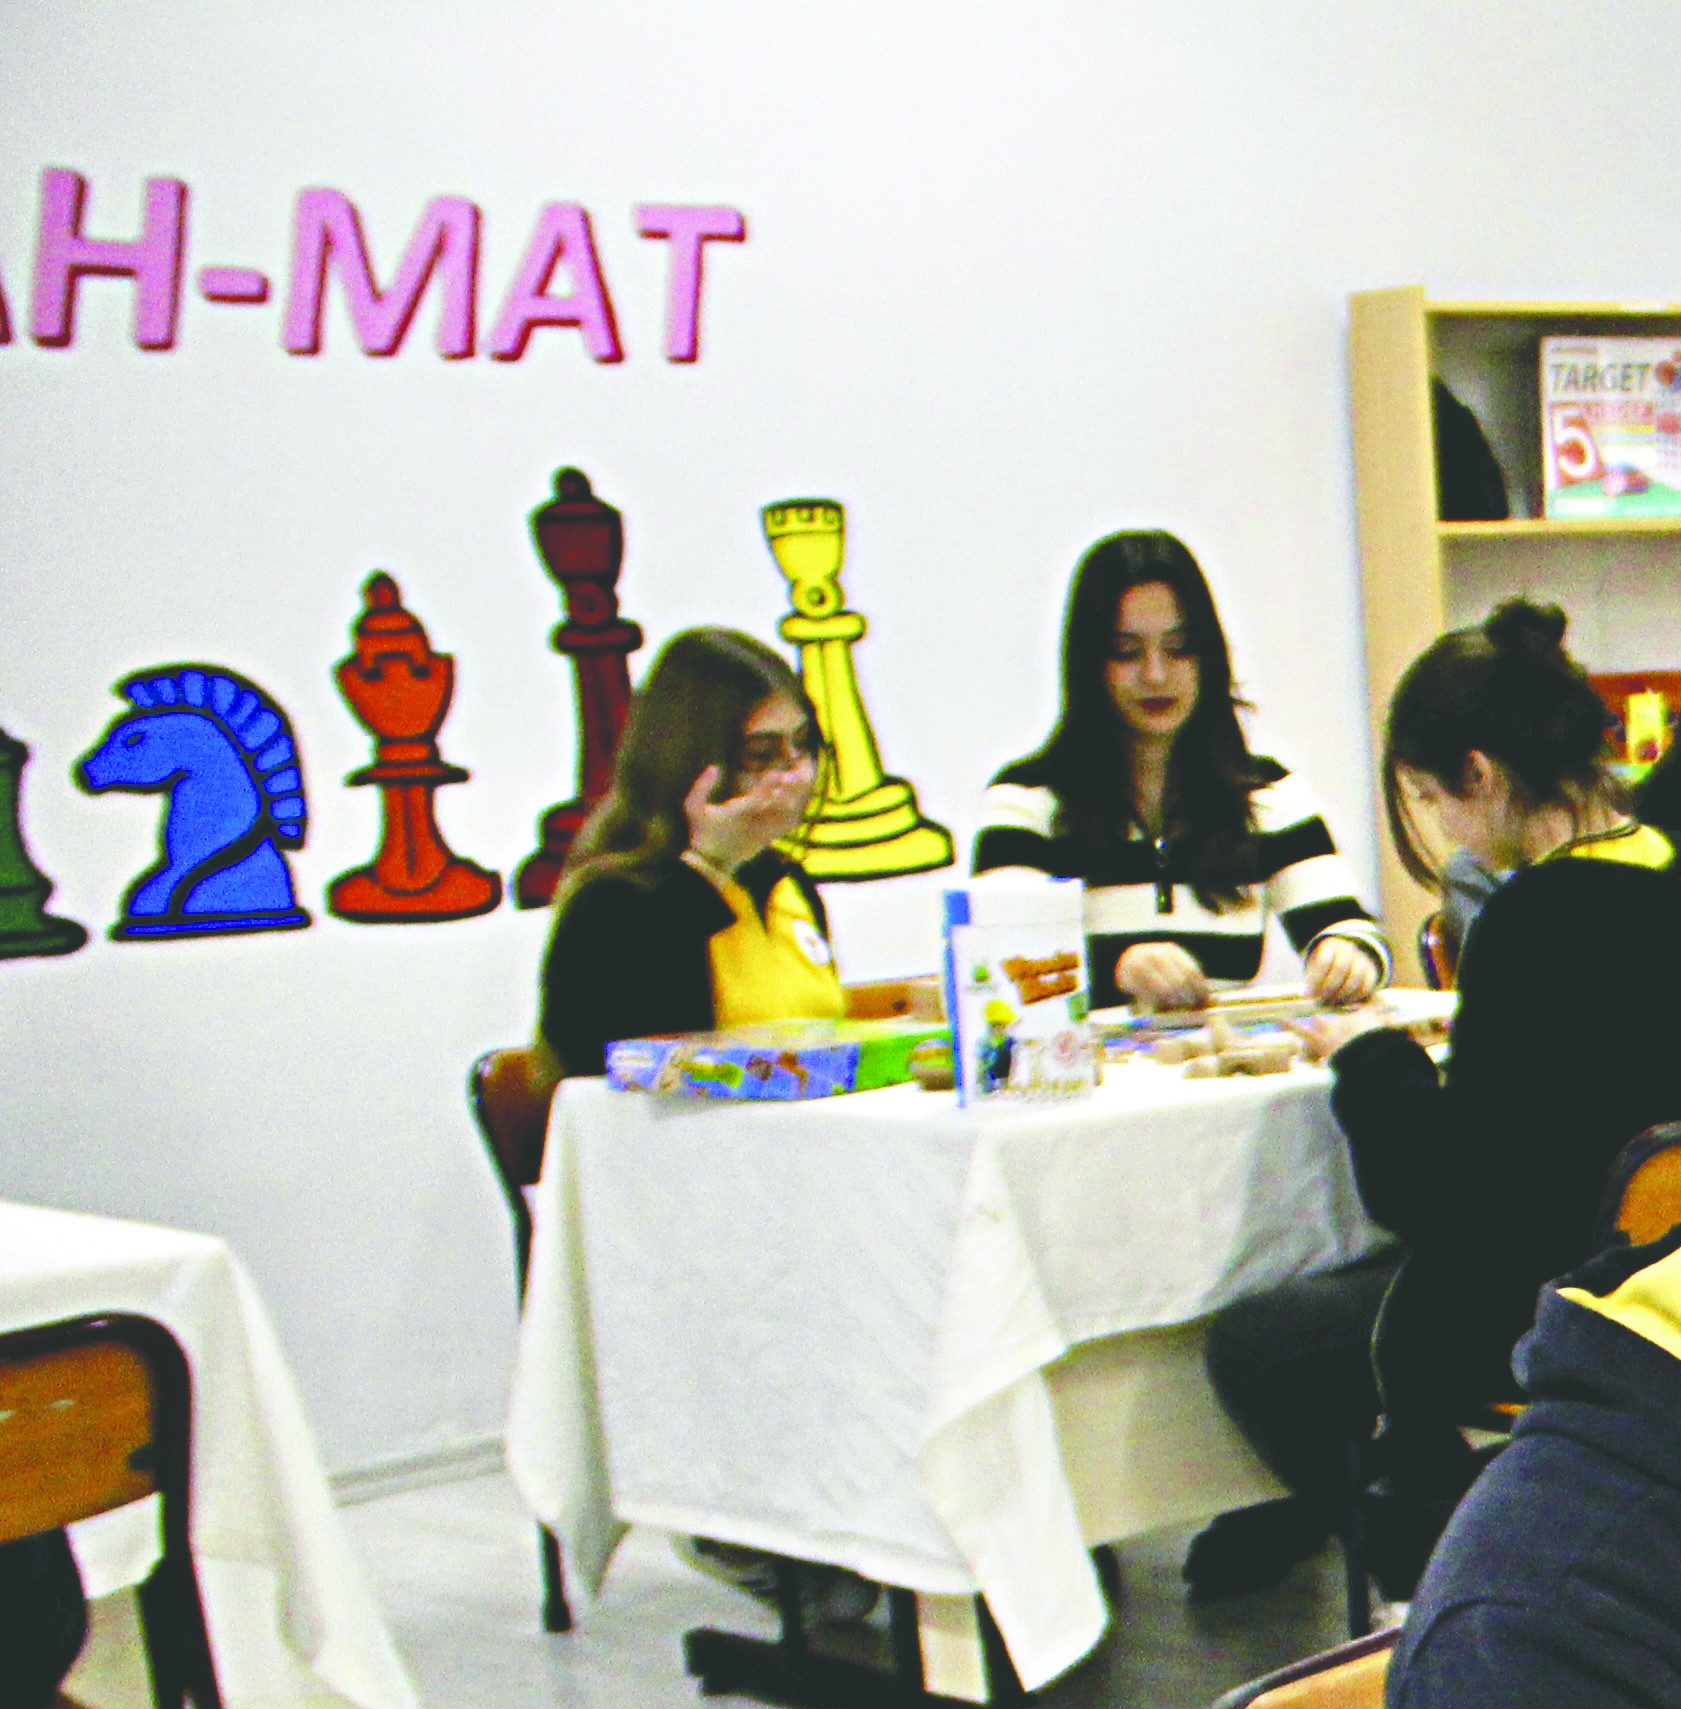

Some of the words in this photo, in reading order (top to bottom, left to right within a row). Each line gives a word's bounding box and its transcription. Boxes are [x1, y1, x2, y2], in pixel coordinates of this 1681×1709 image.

[0, 167, 747, 364] H-MAT
[1550, 361, 1651, 393] TARGET
[1552, 407, 1598, 479] 5
